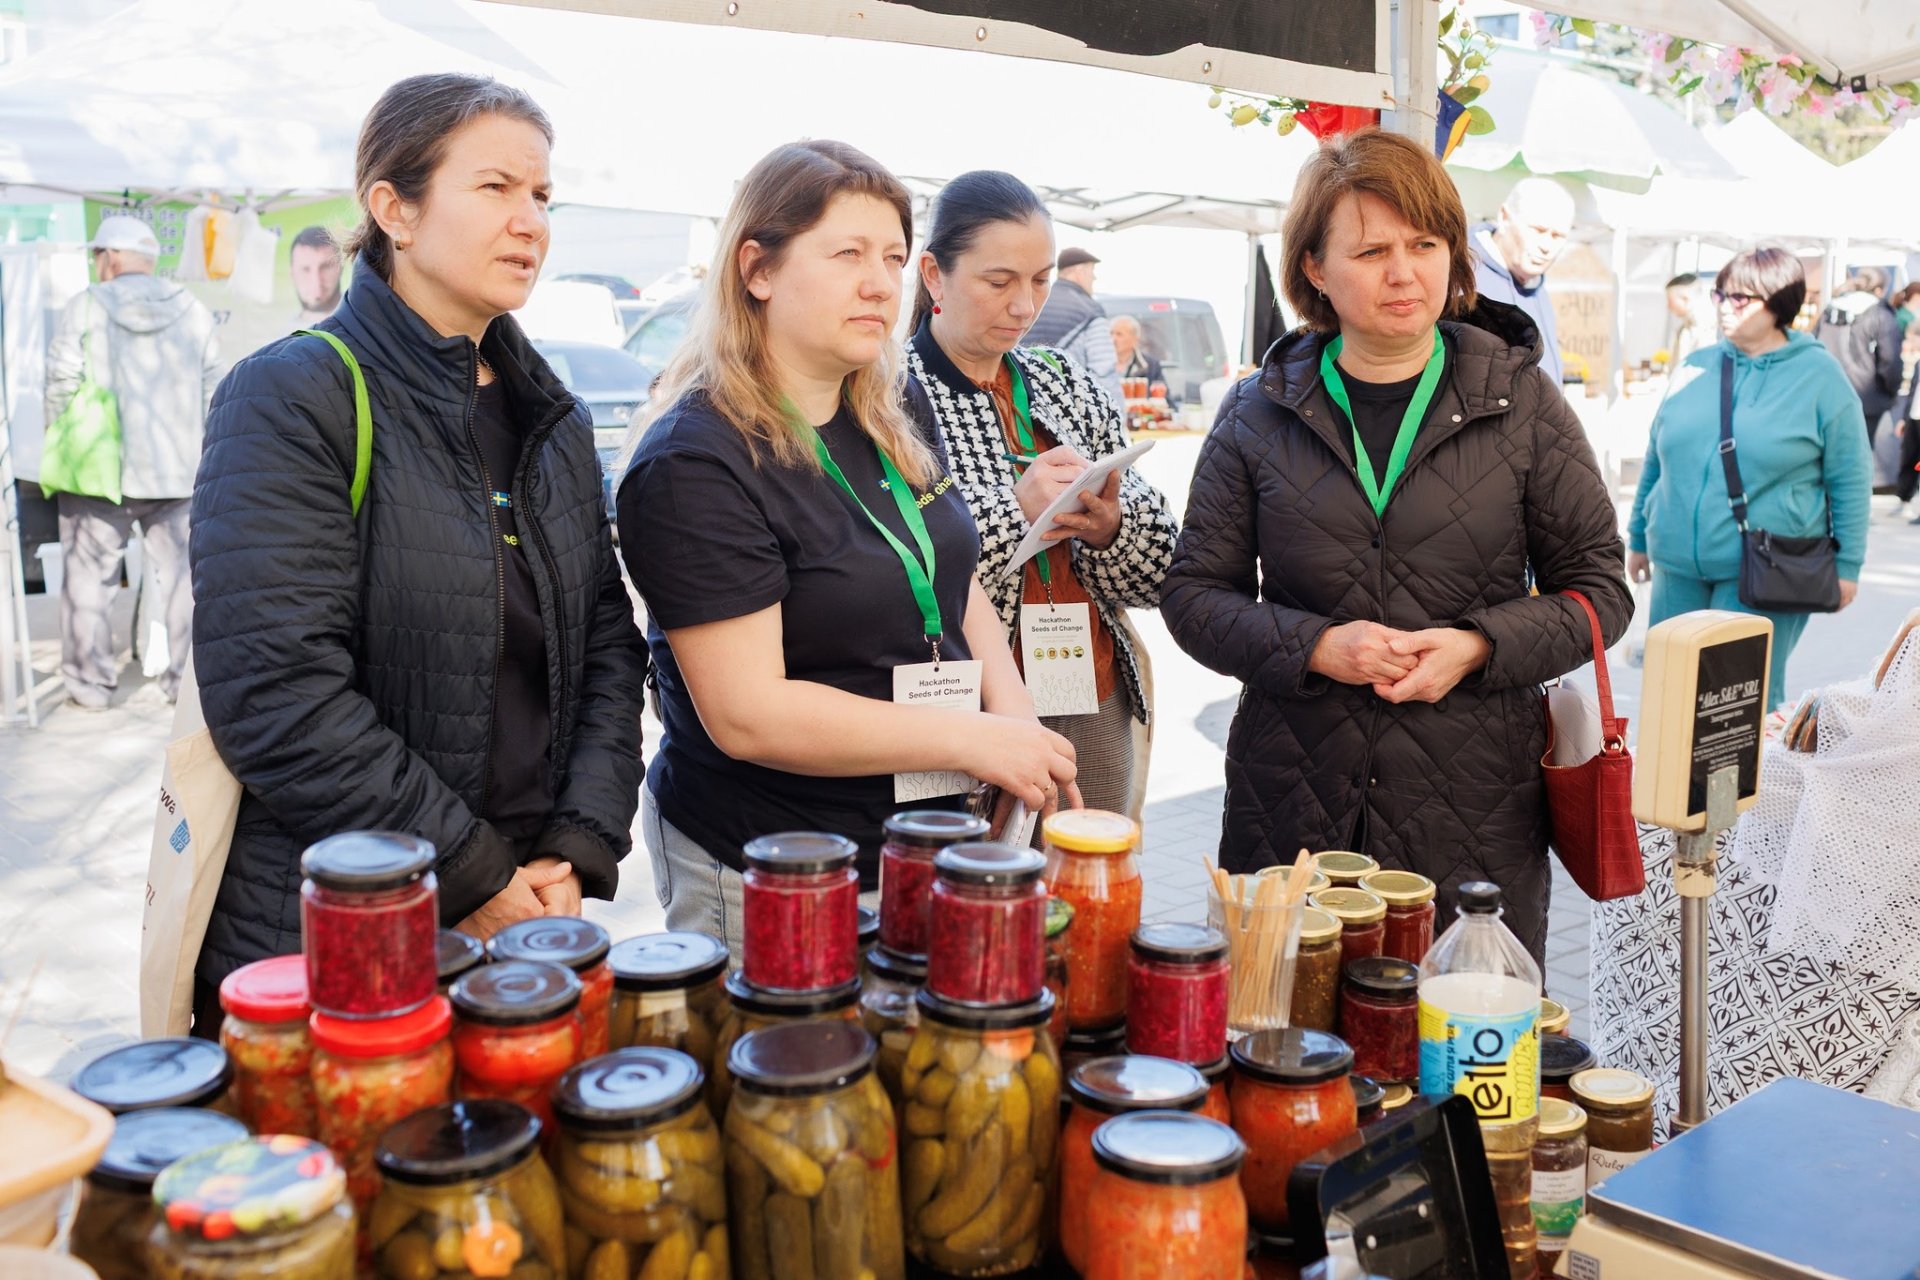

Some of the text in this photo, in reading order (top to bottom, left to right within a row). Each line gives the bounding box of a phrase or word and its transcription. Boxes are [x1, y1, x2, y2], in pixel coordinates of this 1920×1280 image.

[1038, 616, 1072, 624] Hackathon
[1031, 625, 1050, 633] Seeds
[1059, 625, 1084, 633] Change
[919, 677, 961, 687] Hackathon
[1744, 679, 1760, 696] SRL
[908, 687, 974, 700] Seeds of Change
[1459, 1028, 1511, 1120] Letto
